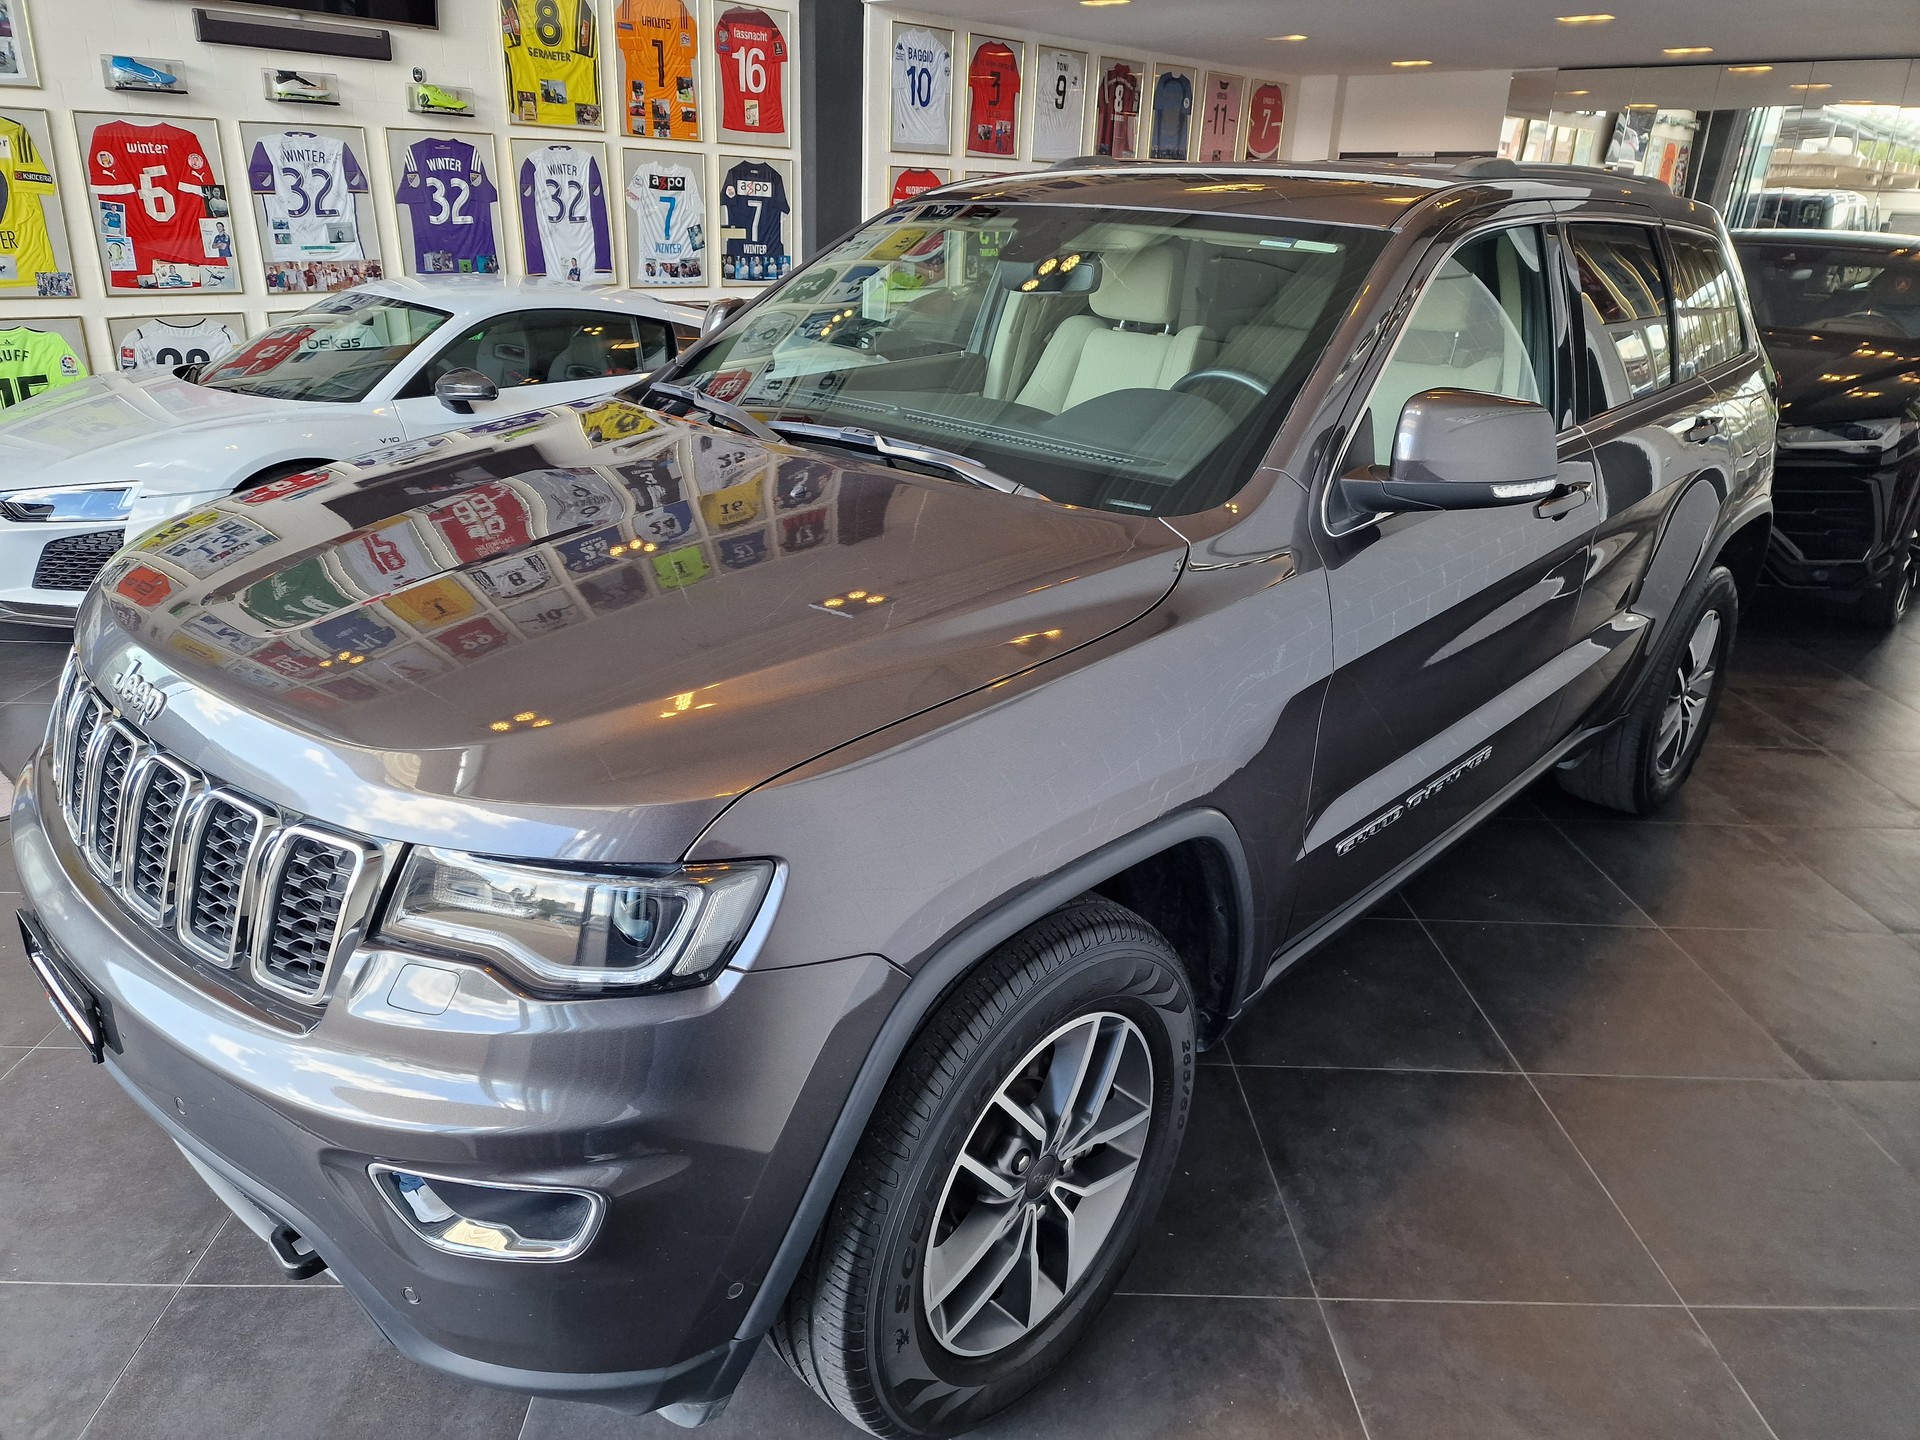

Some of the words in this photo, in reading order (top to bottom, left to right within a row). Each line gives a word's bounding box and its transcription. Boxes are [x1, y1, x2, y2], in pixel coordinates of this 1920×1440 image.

[535, 0, 563, 47] 8
[733, 27, 768, 42] fassnacht
[651, 39, 665, 88] 1
[732, 46, 767, 93] 16
[908, 47, 934, 63] BAGGIO
[907, 66, 932, 108] 10
[988, 71, 1001, 106] 3
[1055, 75, 1067, 110] 9
[1113, 84, 1125, 112] 8
[1213, 103, 1227, 135] 11
[1262, 108, 1272, 139] 7
[126, 141, 169, 154] winter
[282, 149, 326, 163] WINTER
[426, 158, 462, 172] WINTER
[546, 163, 578, 177] WINTER
[137, 165, 176, 222] 6
[281, 166, 341, 218] 32
[425, 177, 474, 225] 32
[545, 178, 588, 223] 32
[659, 196, 676, 240] 7
[747, 200, 763, 242] 7
[655, 242, 682, 254] WINTER
[743, 243, 768, 254] WINTER
[306, 335, 361, 350] bekas
[113, 659, 167, 727] Jeep
